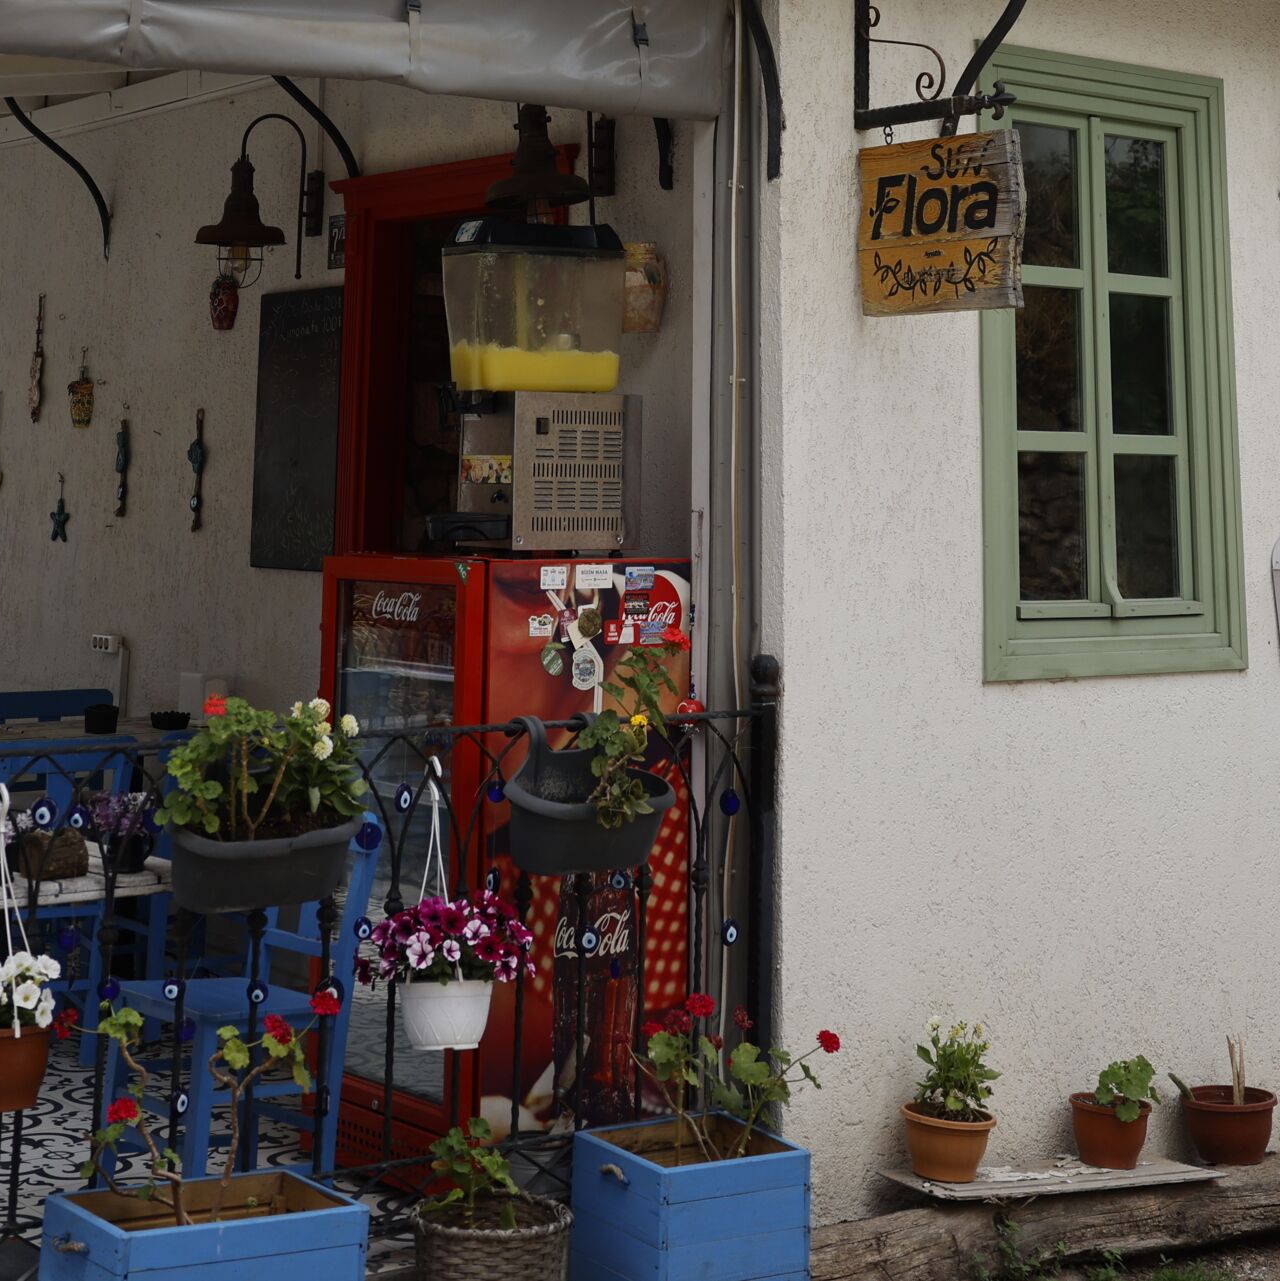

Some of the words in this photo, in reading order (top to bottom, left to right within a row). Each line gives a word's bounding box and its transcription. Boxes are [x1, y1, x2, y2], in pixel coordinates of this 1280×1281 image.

[870, 174, 998, 240] Flora
[372, 590, 422, 622] Coca-Cola
[621, 601, 679, 625] -Cola
[553, 908, 631, 959] CocaCola
